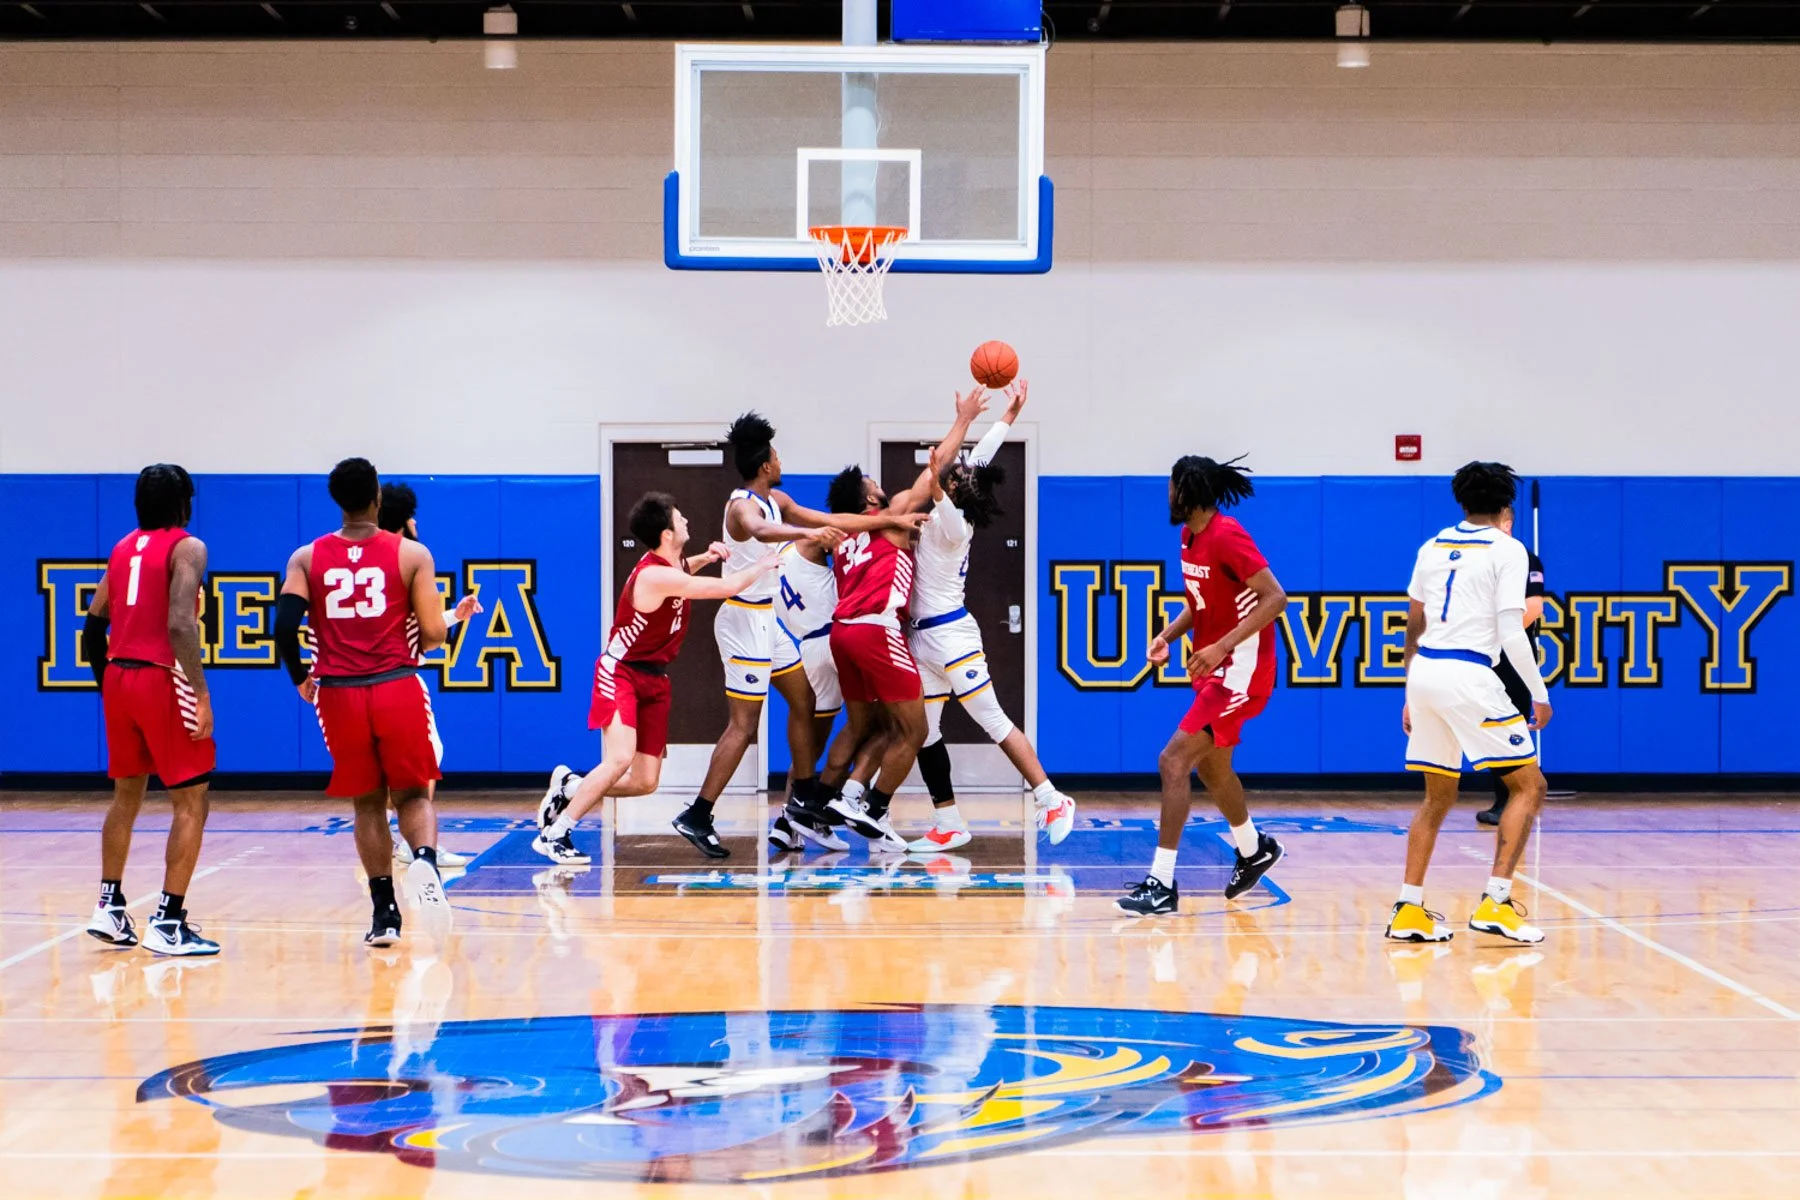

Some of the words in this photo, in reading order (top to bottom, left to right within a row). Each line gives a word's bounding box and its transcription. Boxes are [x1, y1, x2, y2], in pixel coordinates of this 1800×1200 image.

[622, 539, 635, 548] 120
[838, 531, 873, 575] 32
[1006, 539, 1018, 548] 121
[126, 554, 143, 606] 1
[323, 566, 387, 619] 23
[1440, 569, 1457, 623] 1
